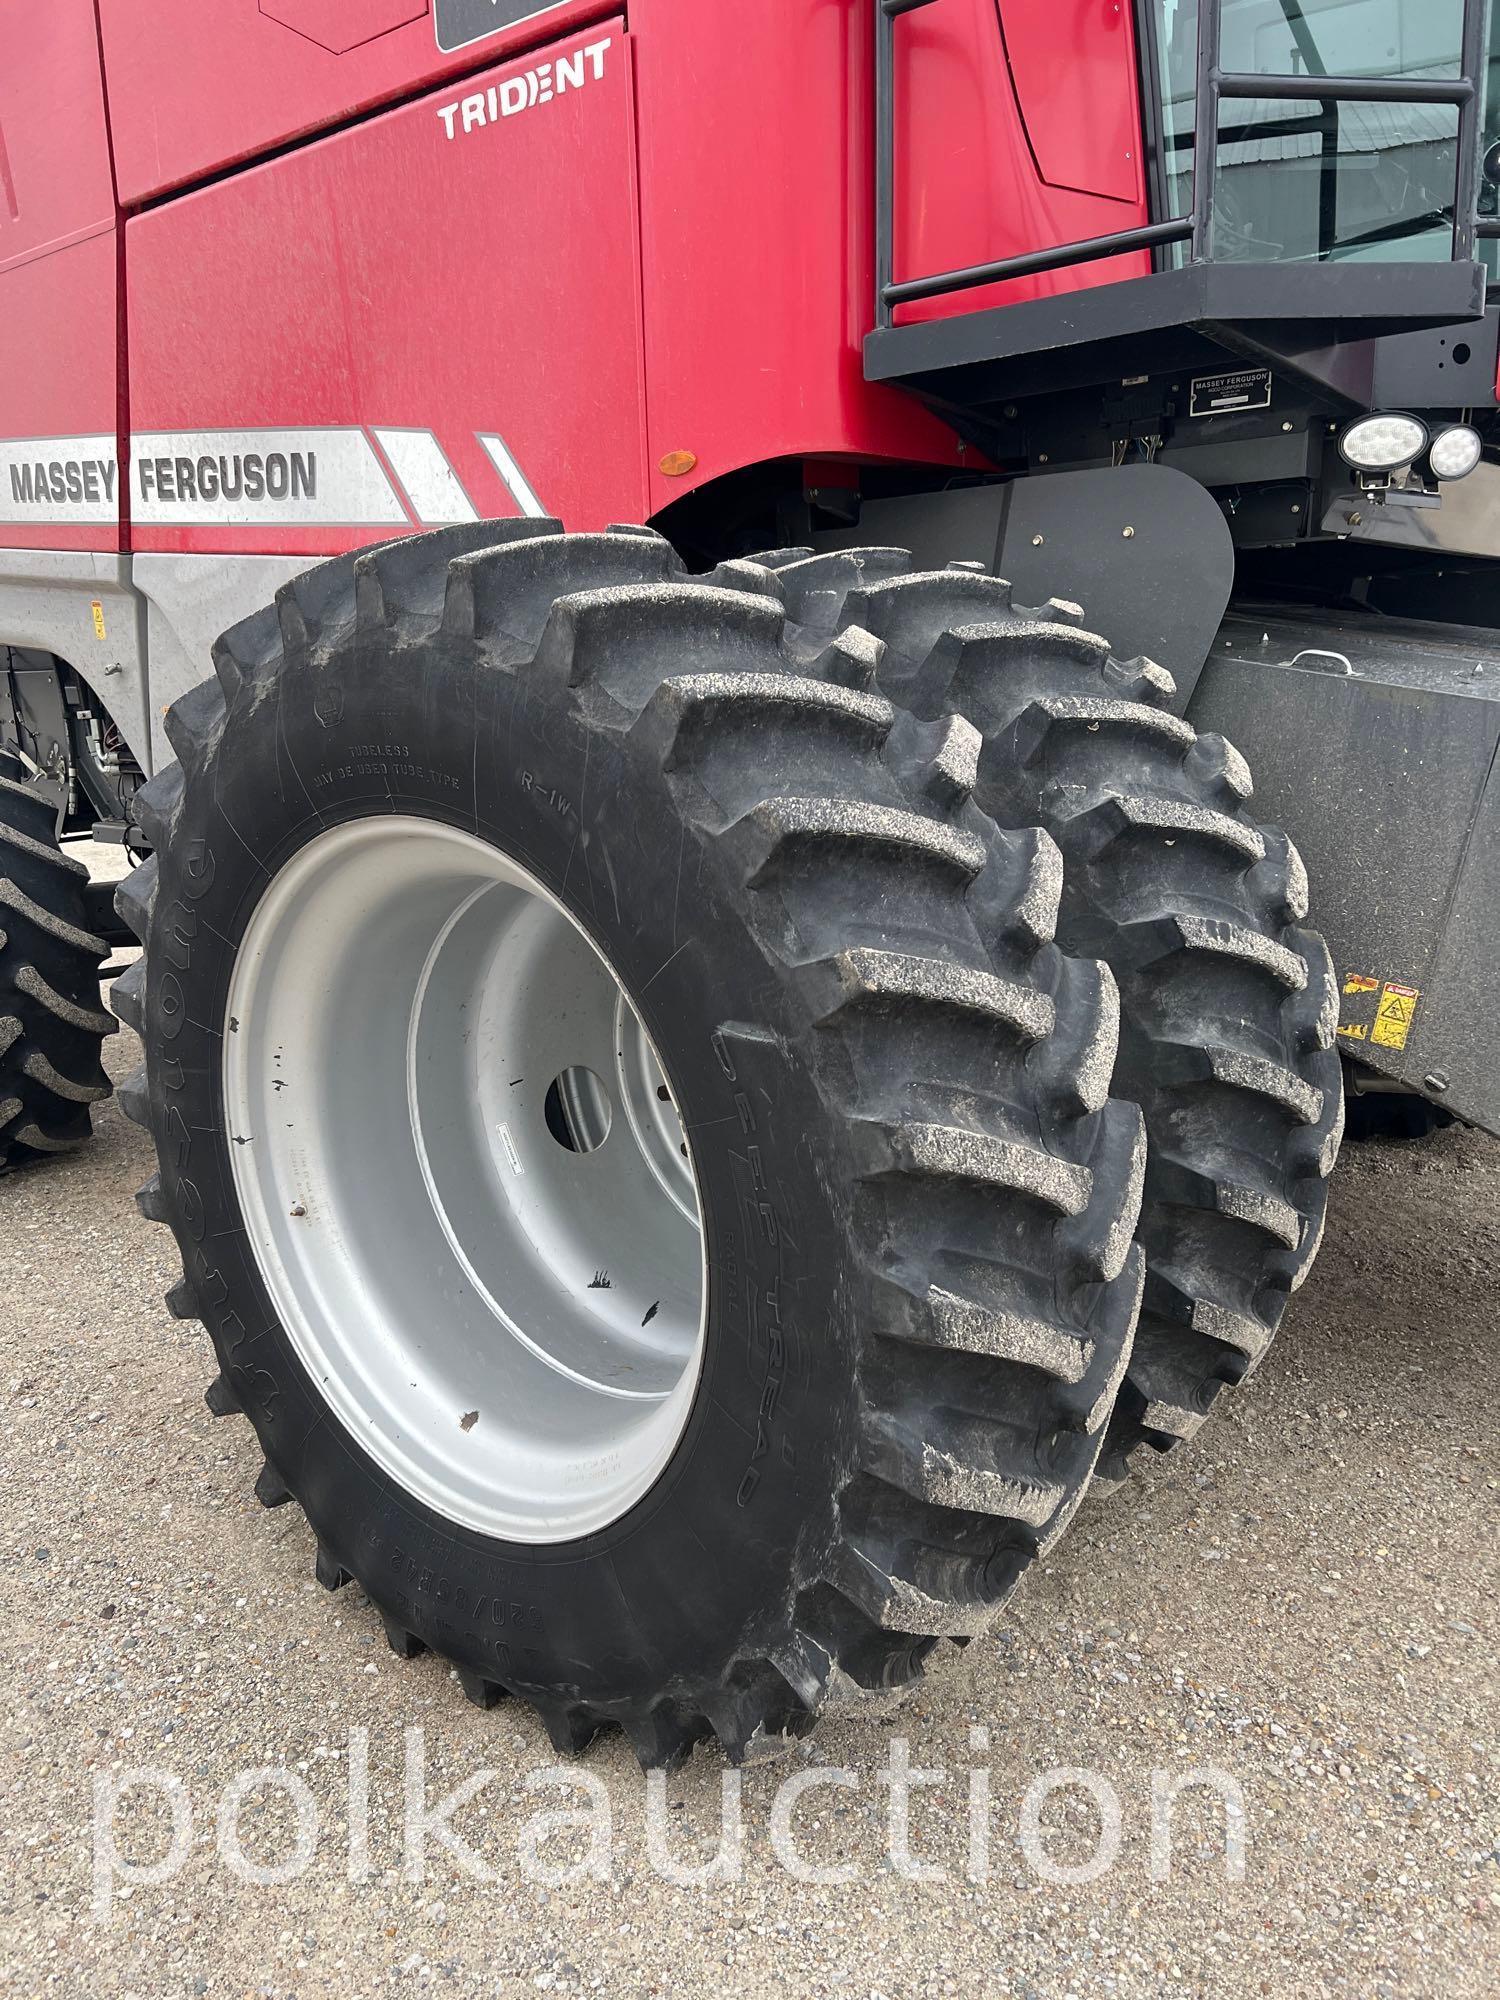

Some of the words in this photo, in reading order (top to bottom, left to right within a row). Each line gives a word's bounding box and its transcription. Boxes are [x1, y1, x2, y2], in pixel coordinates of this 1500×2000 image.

[436, 37, 612, 140] TRIDENT
[1196, 379, 1225, 390] MASSEY
[1226, 373, 1268, 385] FERGUSON
[9, 459, 116, 503] MASSEY
[138, 451, 317, 503] FERGUSON
[338, 765, 354, 779] BE
[357, 763, 388, 775] USED
[393, 763, 425, 778] TUBE
[348, 745, 410, 758] TUBELESS
[521, 769, 573, 816] R-1W
[711, 1031, 778, 1247] DEEP
[724, 1230, 740, 1313] RADIAL
[736, 1275, 784, 1508] TREAD
